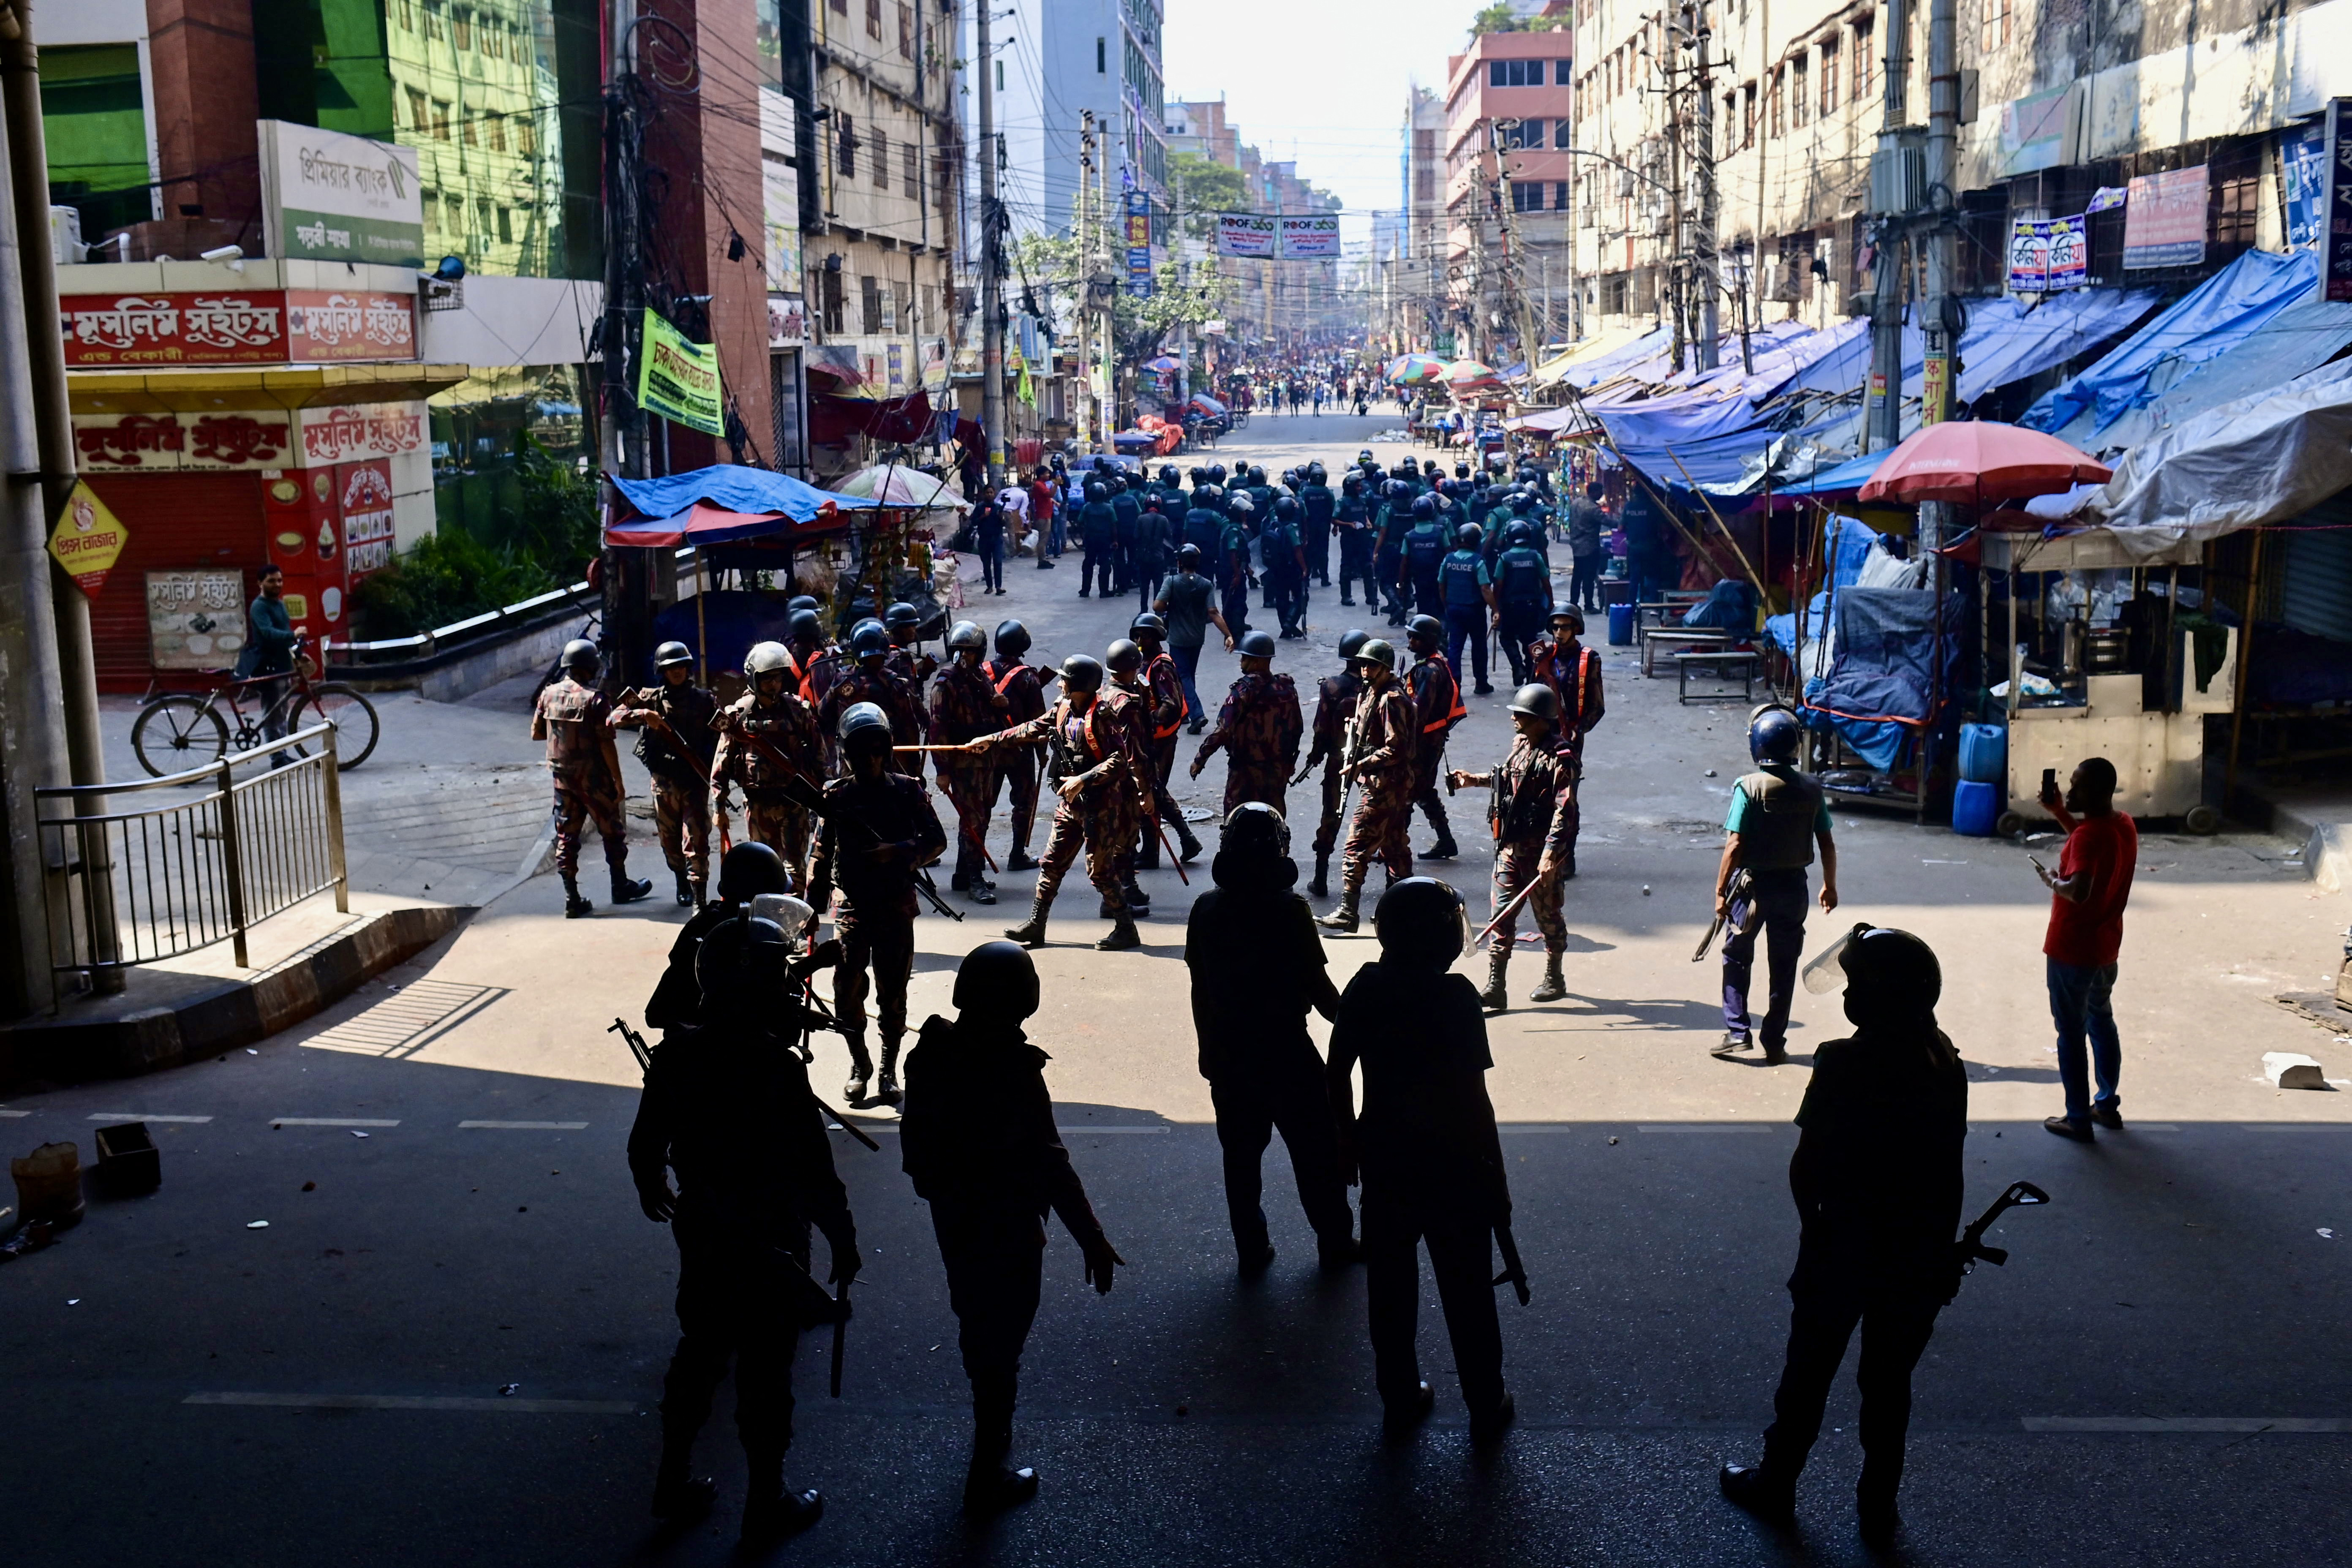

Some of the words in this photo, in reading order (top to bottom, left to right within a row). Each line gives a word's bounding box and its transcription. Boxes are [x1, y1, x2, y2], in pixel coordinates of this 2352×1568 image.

[300, 146, 350, 190] প্রিমিয়ার
[354, 165, 387, 195] ব্যাংক
[1221, 217, 1250, 228] ROOF
[1284, 221, 1312, 229] ROOF
[74, 298, 179, 348] মুসলিম
[304, 294, 362, 345] মুসলিম
[77, 415, 185, 465] মুসলিম
[304, 408, 366, 459] মুসলিম
[82, 531, 117, 550] বাজার
[1447, 562, 1472, 572] POLICE
[1085, 719, 1098, 751] BGB
